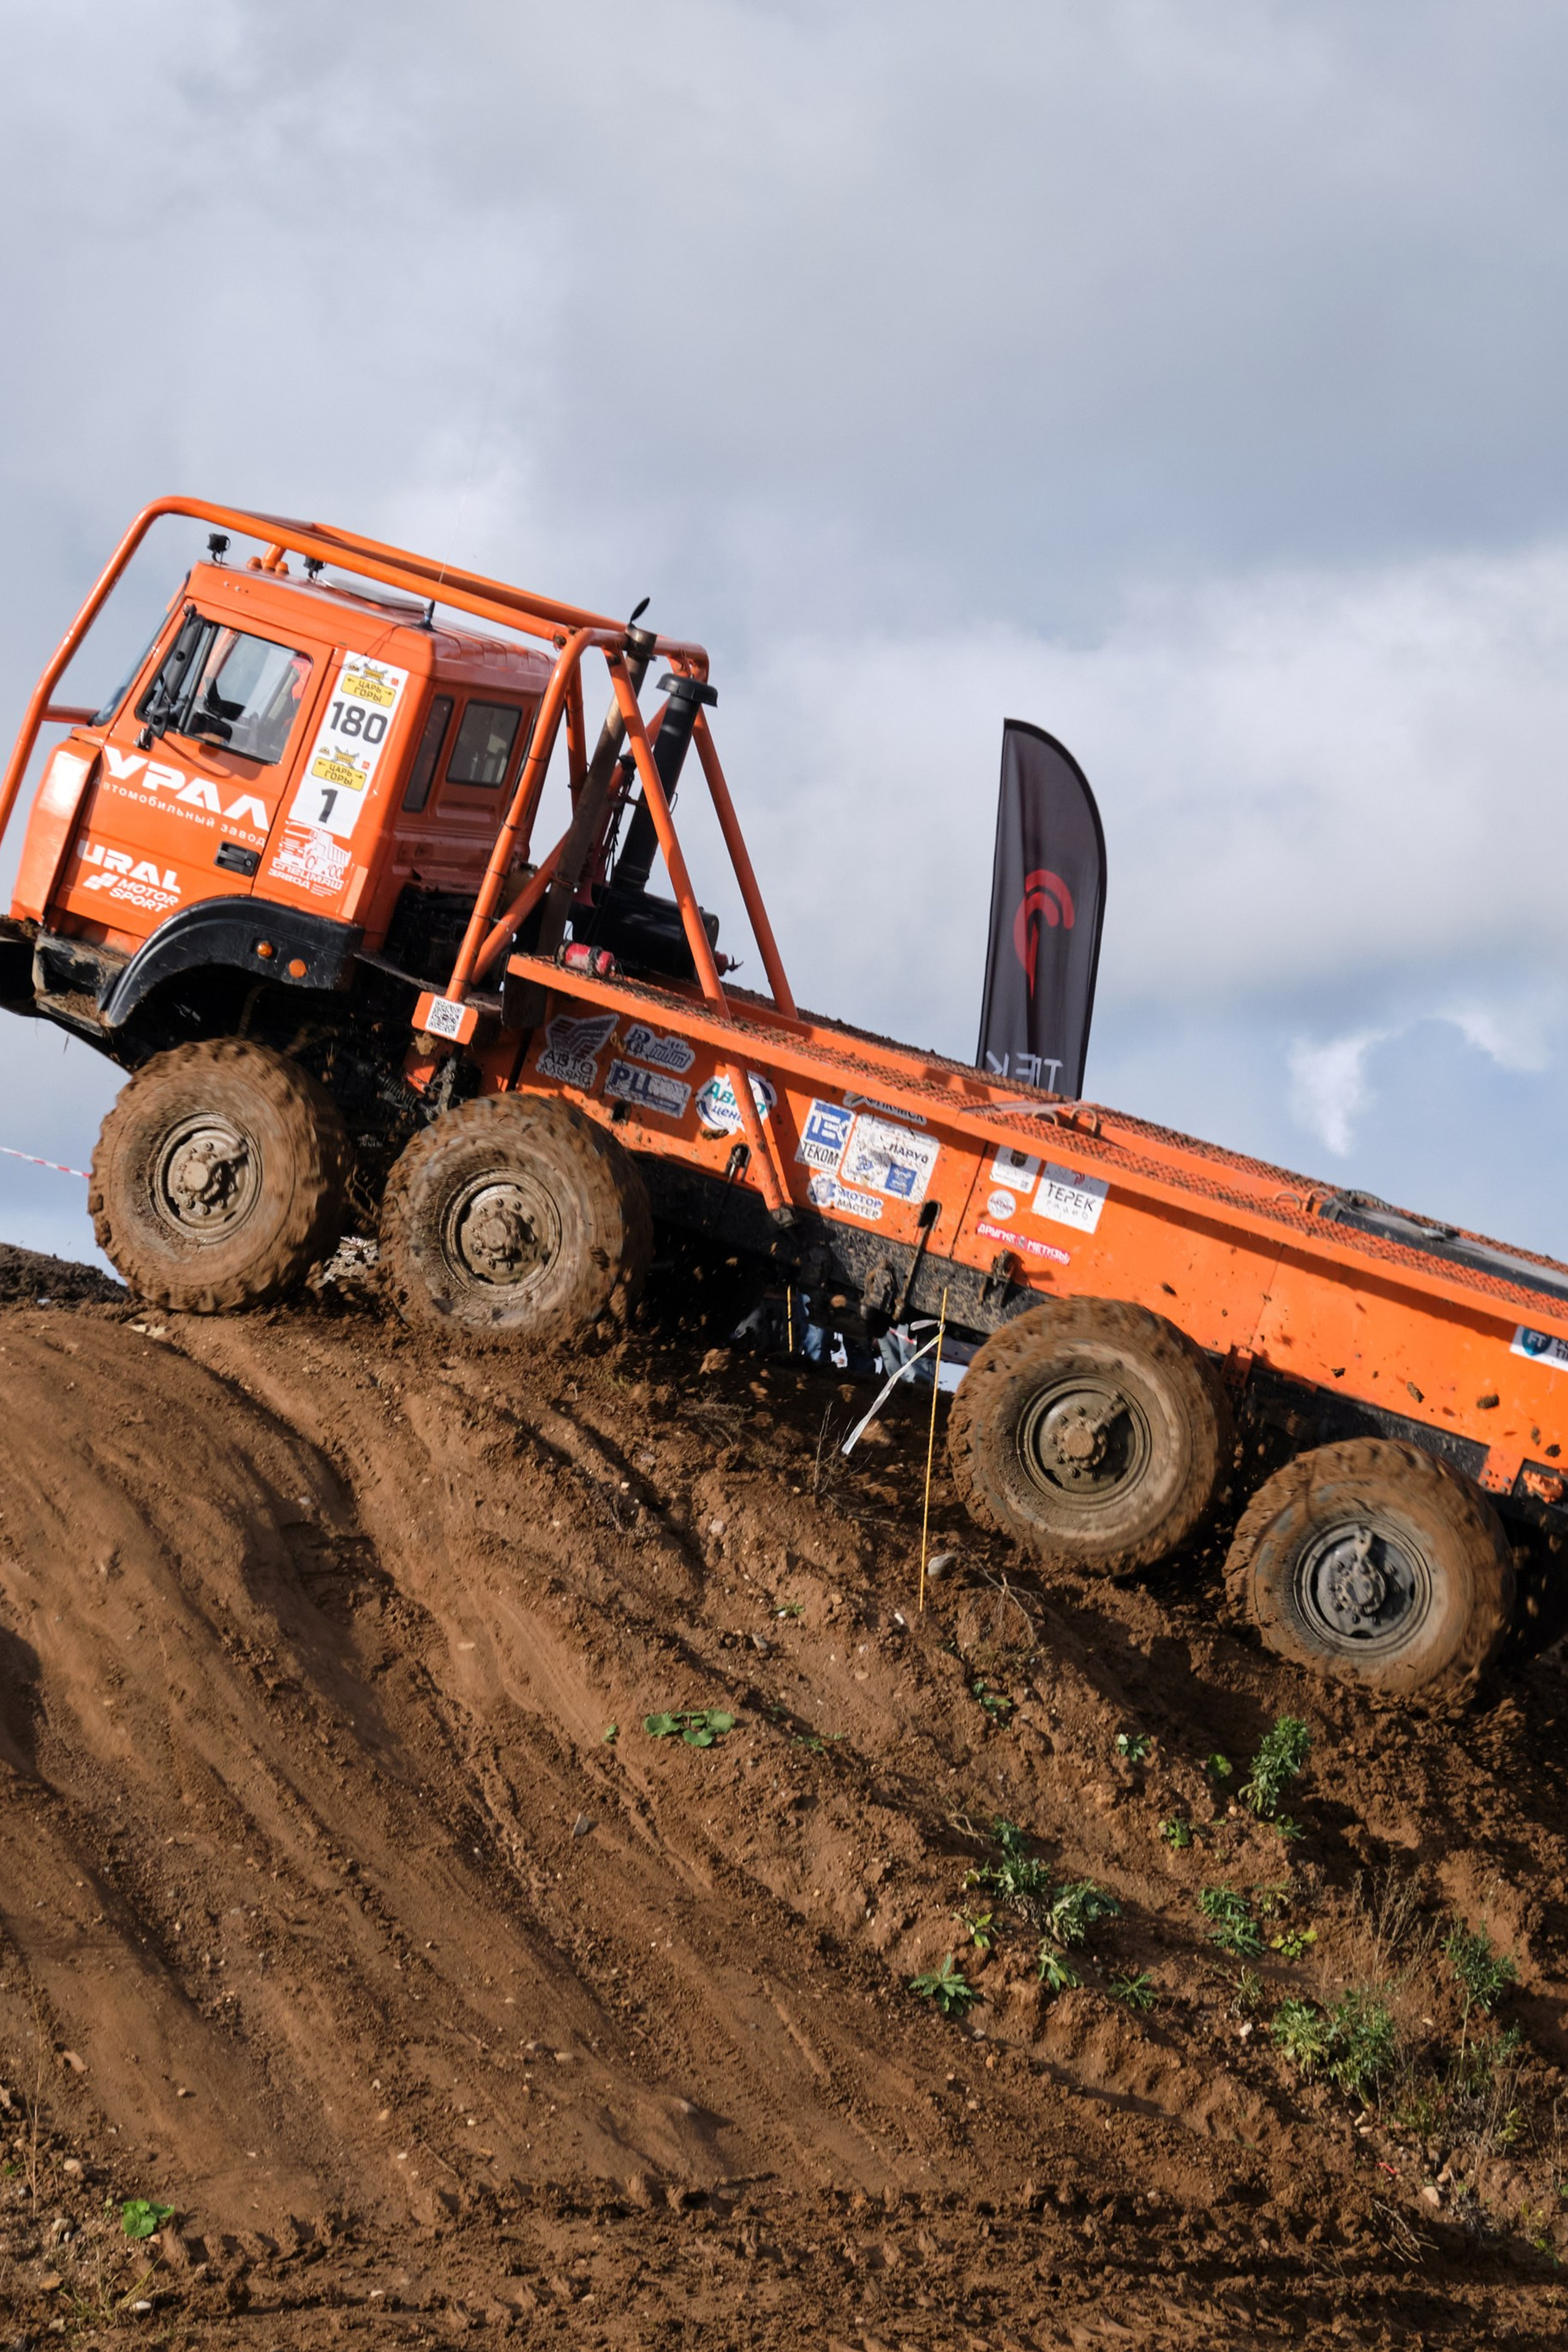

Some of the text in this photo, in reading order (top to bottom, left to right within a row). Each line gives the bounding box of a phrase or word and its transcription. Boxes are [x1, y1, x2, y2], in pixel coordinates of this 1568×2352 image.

[354, 687, 382, 702] ГОРЫ
[359, 680, 382, 693] ЦАРЬ
[330, 701, 388, 744] 180
[325, 770, 353, 785] ГОРЫ
[329, 764, 352, 777] ЦАРЬ
[318, 788, 338, 824] 1
[220, 823, 265, 848] завод
[77, 839, 181, 894] URAL
[109, 888, 168, 913] SPORT
[117, 878, 179, 907] MOTOR
[1048, 1183, 1096, 1212] ТЕРЕК
